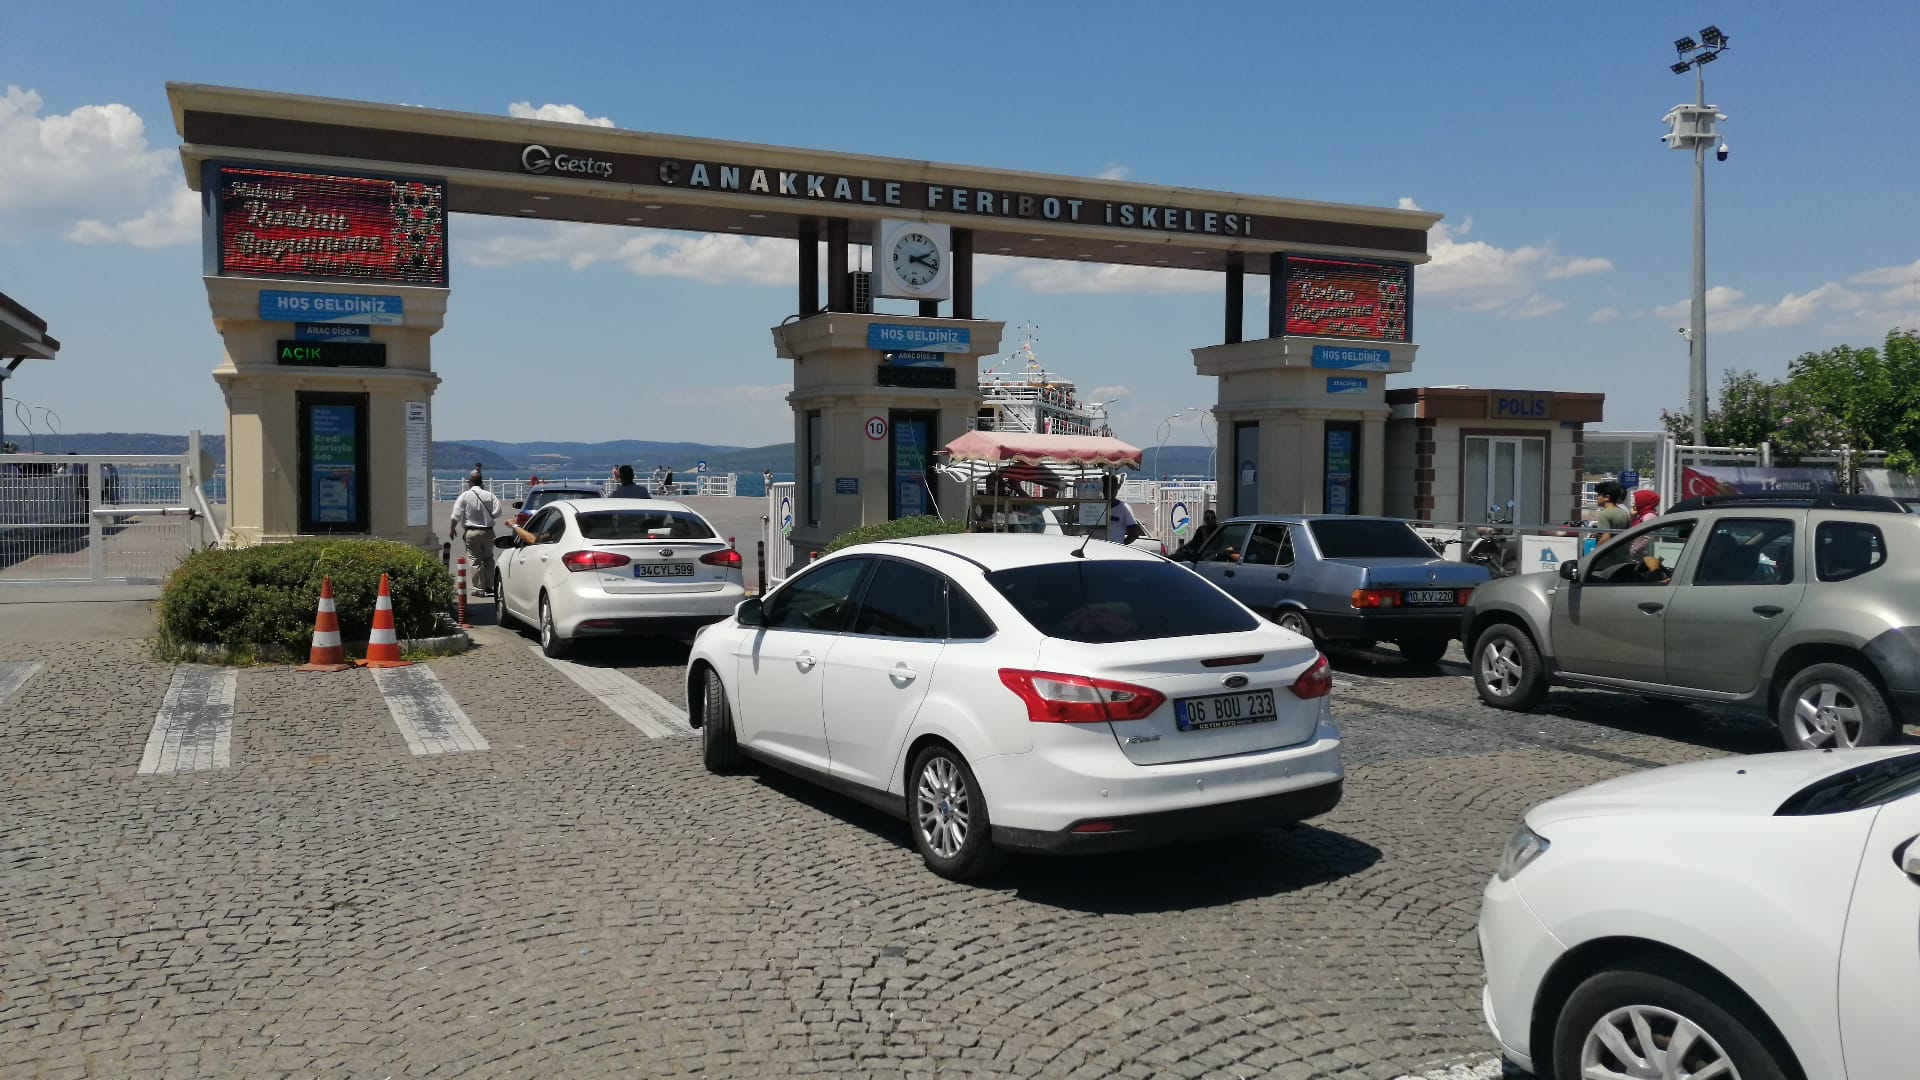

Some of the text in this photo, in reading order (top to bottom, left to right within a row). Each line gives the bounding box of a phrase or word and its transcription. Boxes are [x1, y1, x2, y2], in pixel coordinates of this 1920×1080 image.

[554, 153, 613, 178] Gestaş
[911, 233, 922, 242] 12
[277, 296, 386, 313] HOŞ GELDİNİZ
[881, 328, 959, 343] HOŞ GELDİNİZ
[282, 346, 320, 360] AÇIK
[1322, 350, 1382, 362] HOŞ GELDİNİZ
[869, 422, 883, 434] 10
[698, 462, 706, 472] 2
[1768, 478, 1811, 491] Temmuz
[1187, 694, 1273, 723] 06 BOU 233
